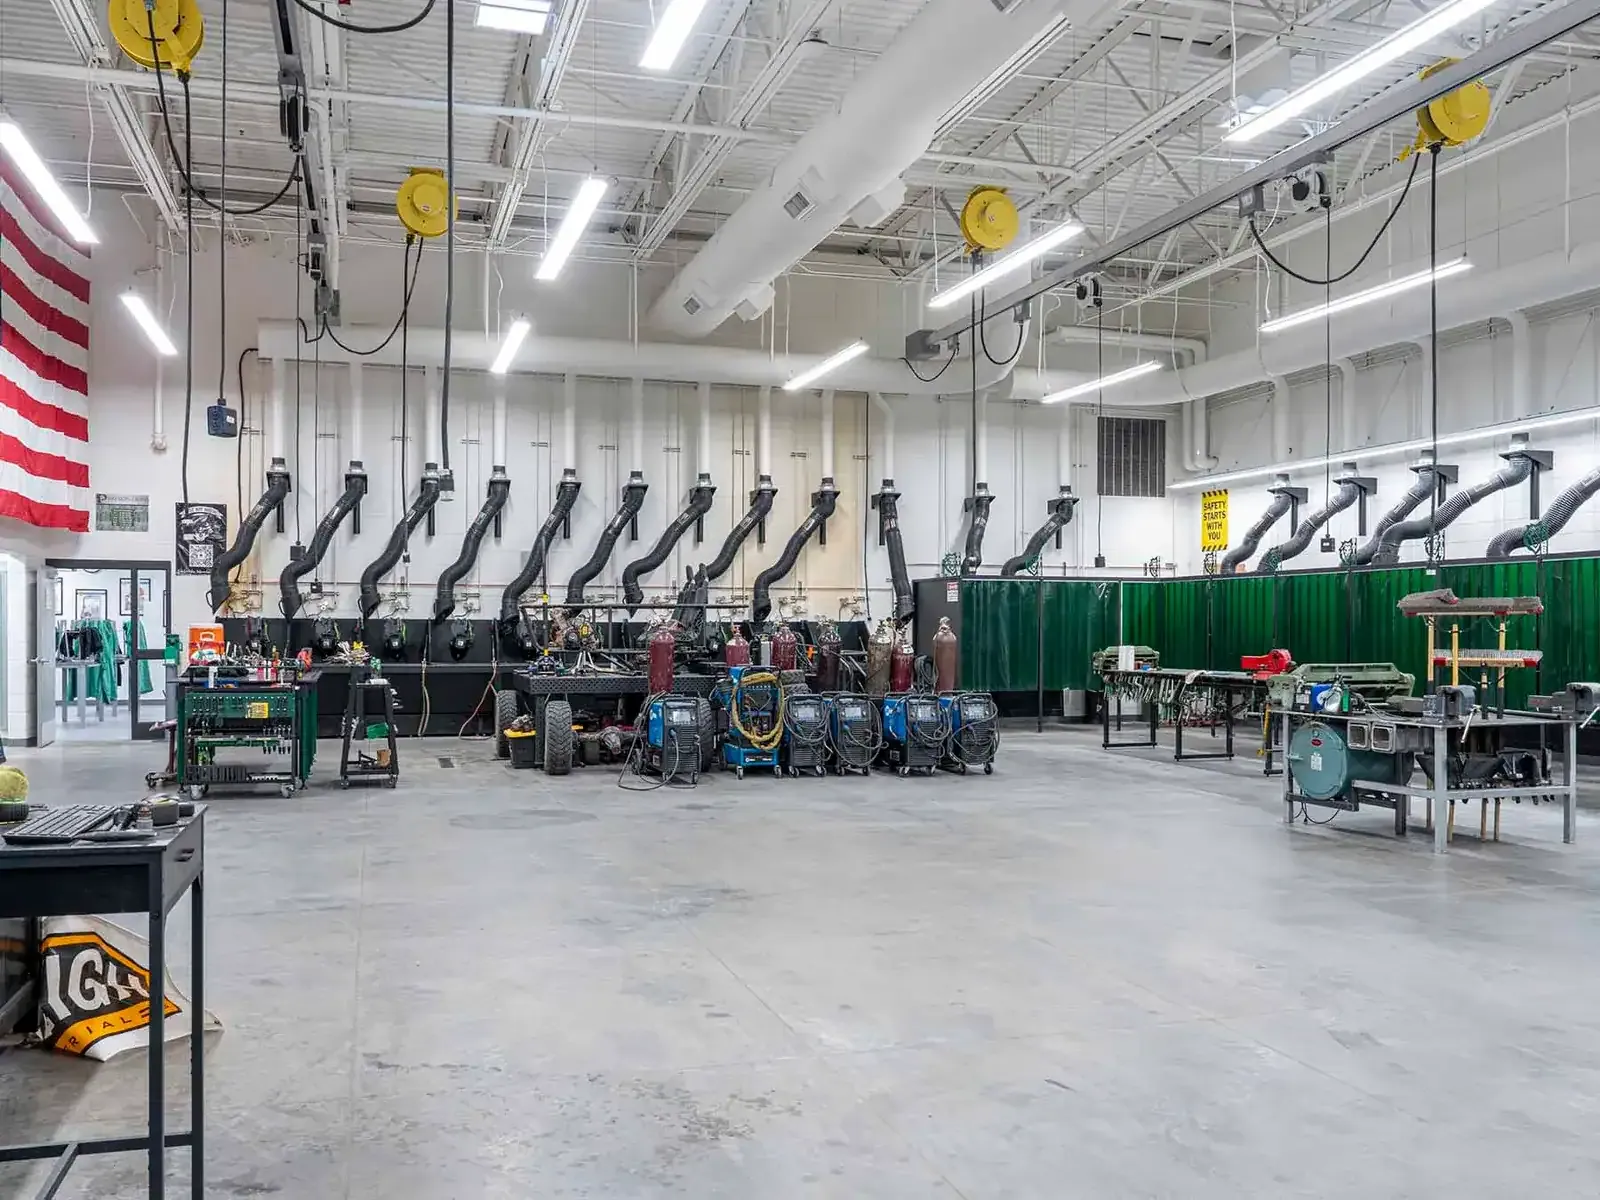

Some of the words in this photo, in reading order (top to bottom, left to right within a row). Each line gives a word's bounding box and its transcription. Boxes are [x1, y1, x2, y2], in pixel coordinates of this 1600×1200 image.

[1204, 501, 1226, 510] SAFETY
[1203, 511, 1226, 520] STARTS
[1207, 522, 1222, 530] WITH
[1208, 532, 1220, 540] YOU
